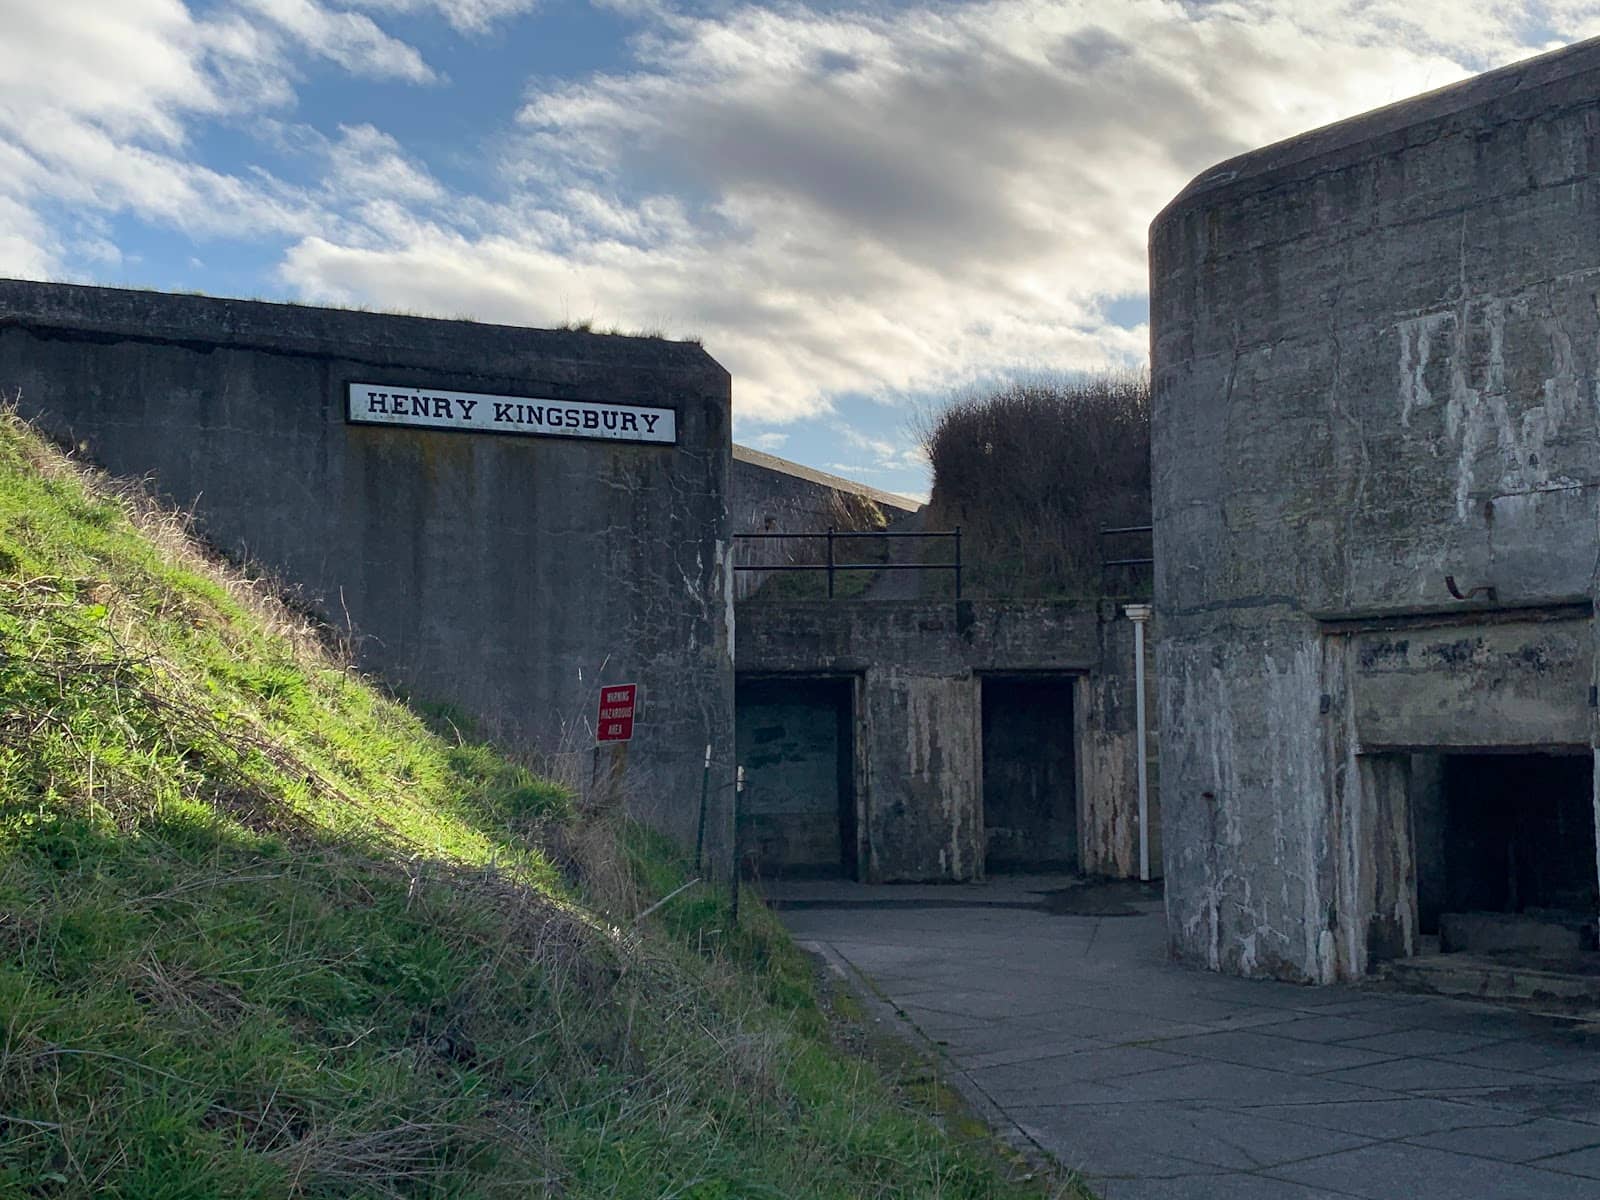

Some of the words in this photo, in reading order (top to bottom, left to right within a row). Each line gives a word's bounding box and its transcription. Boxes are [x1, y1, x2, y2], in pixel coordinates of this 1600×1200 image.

[368, 393, 477, 420] HENRY
[494, 403, 660, 433] KINGSBURY
[607, 691, 629, 703] WARNING
[601, 707, 632, 719] HAZARDOUS
[608, 724, 622, 735] AREA
